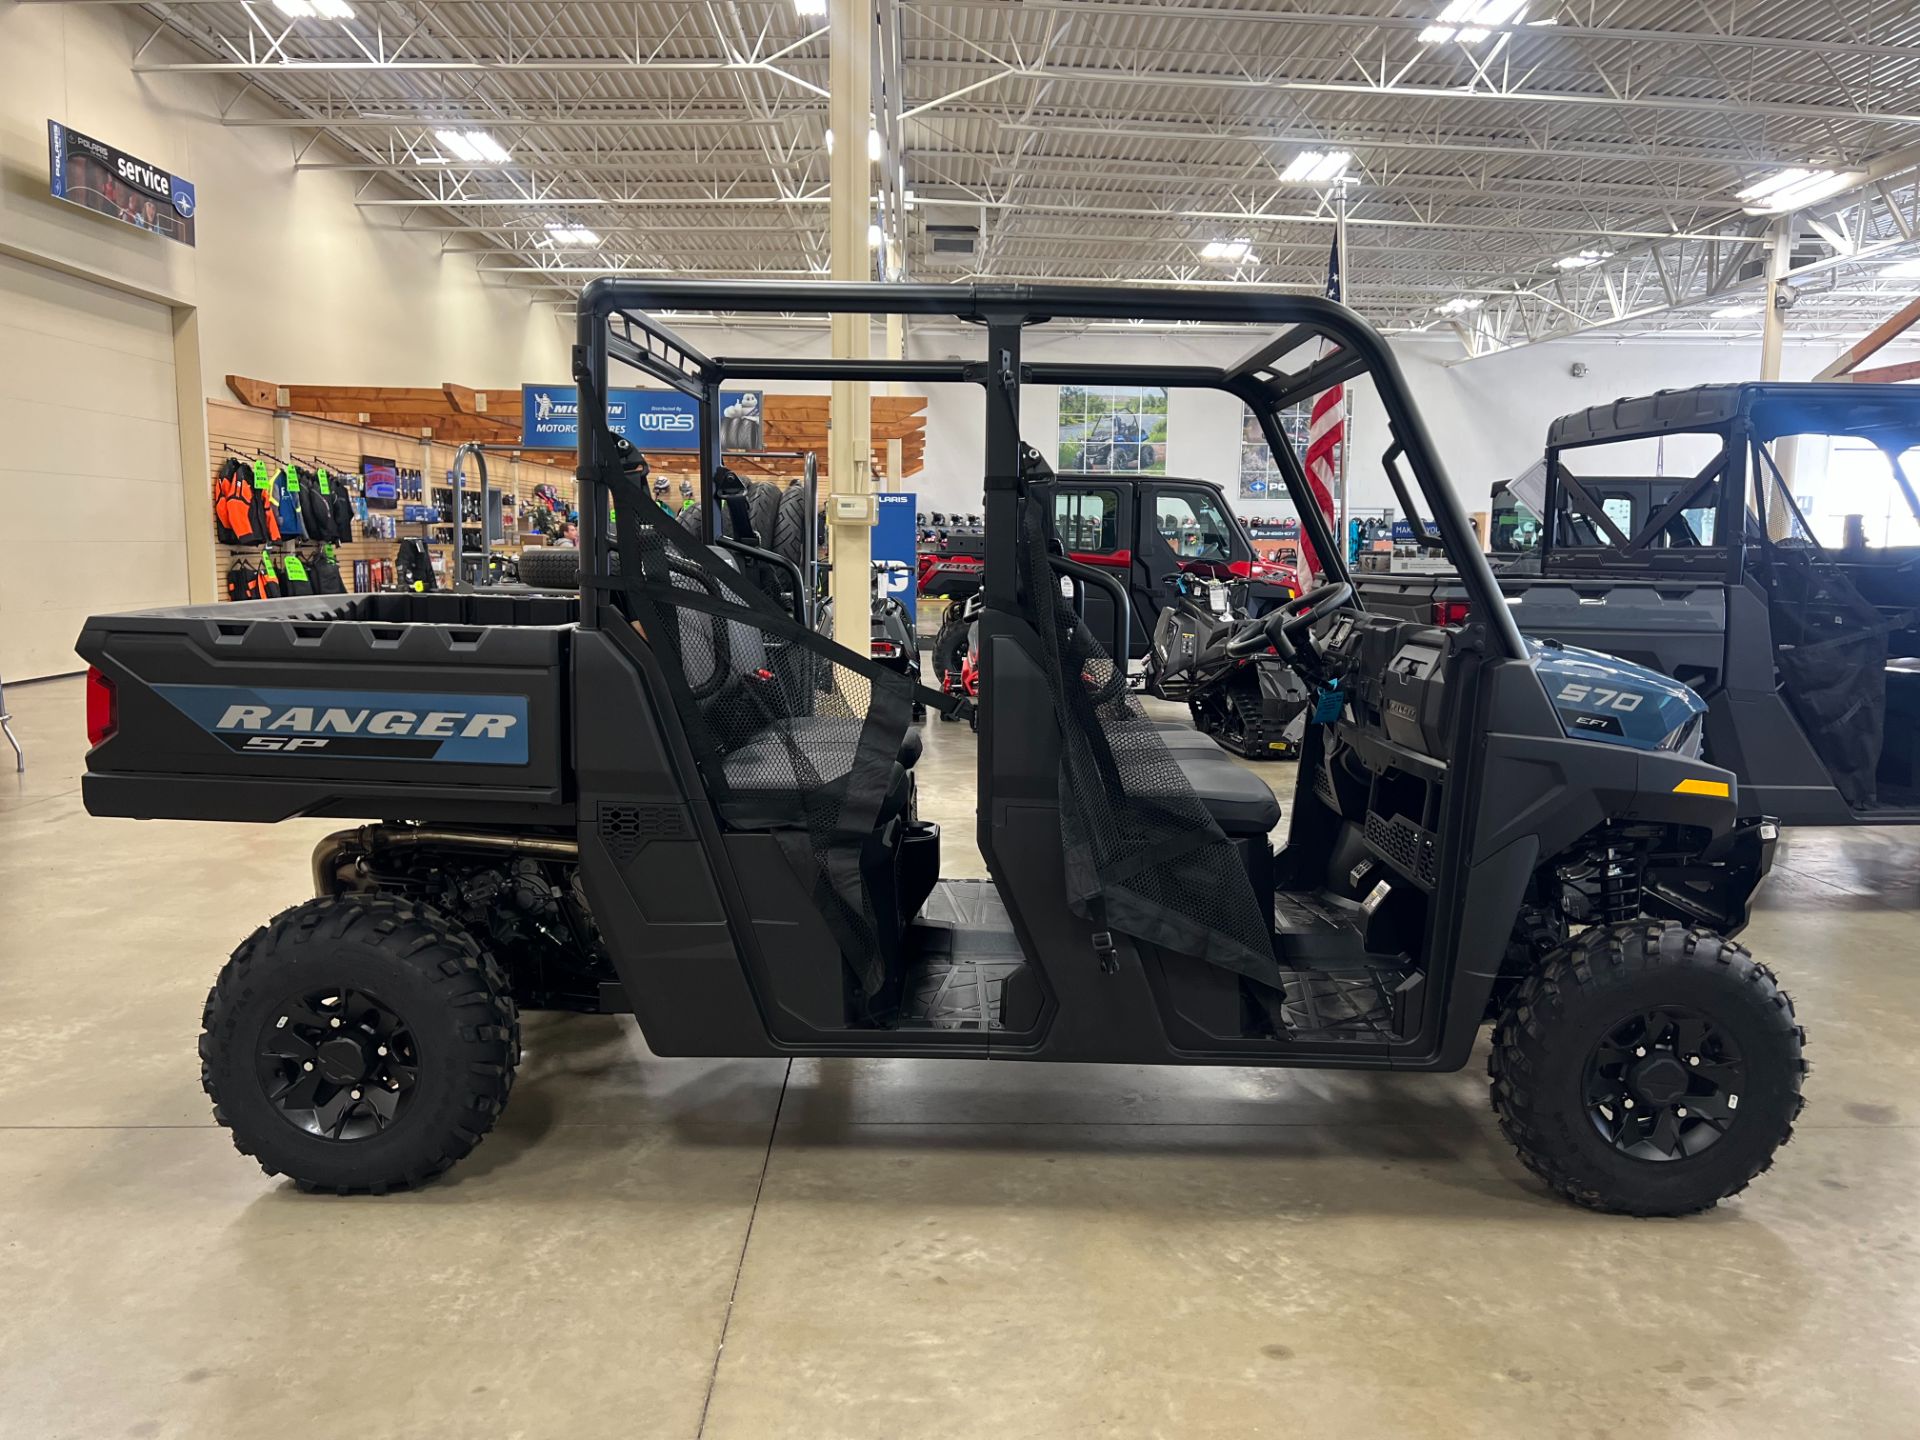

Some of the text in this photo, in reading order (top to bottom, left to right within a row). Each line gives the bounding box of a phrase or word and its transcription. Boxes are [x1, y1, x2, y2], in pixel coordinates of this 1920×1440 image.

[77, 136, 108, 156] POLARIS
[117, 157, 169, 194] service
[553, 404, 623, 414] MICIN
[536, 424, 577, 432] MOTORC
[639, 413, 694, 431] WPS
[216, 705, 517, 738] RANGER
[1576, 717, 1608, 728] EFI
[242, 736, 330, 751] SP
